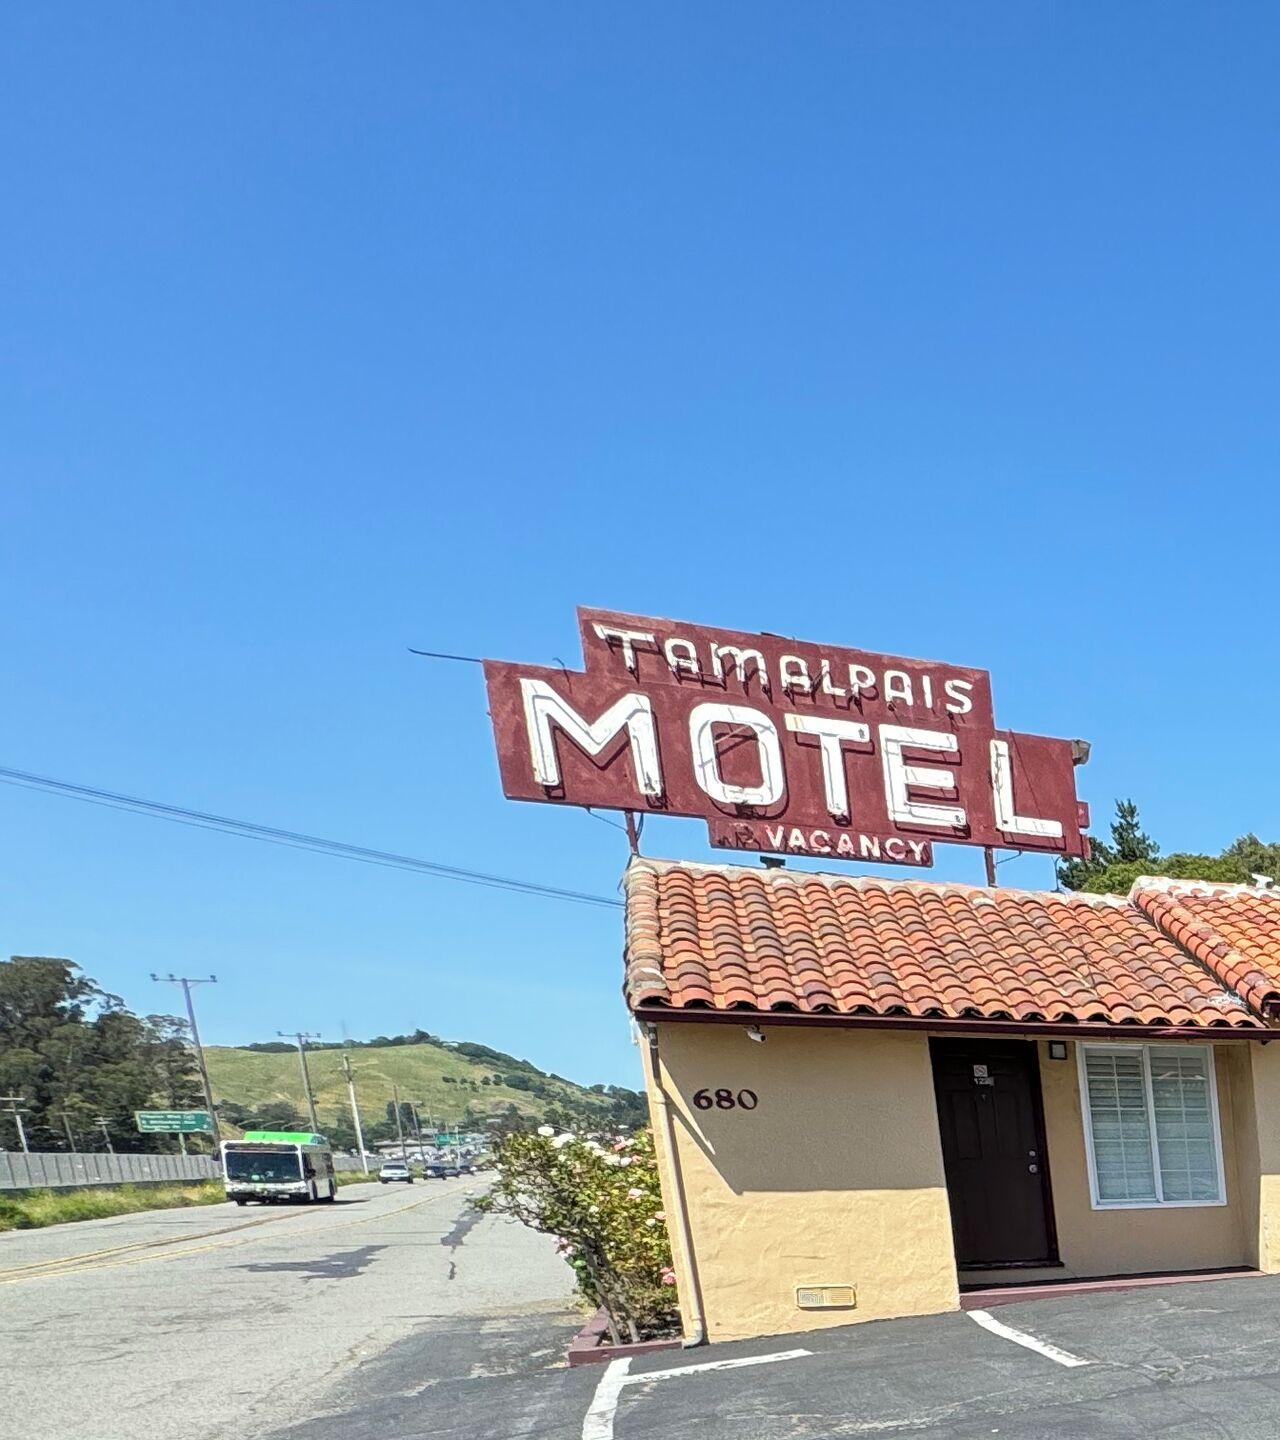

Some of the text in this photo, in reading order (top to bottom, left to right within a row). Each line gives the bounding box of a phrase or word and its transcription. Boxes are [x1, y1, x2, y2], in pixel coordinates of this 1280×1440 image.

[592, 623, 973, 714] TAMALPAIS
[519, 677, 1063, 838] MOTEL
[764, 824, 928, 861] VACANCY
[693, 1088, 759, 1111] 680
